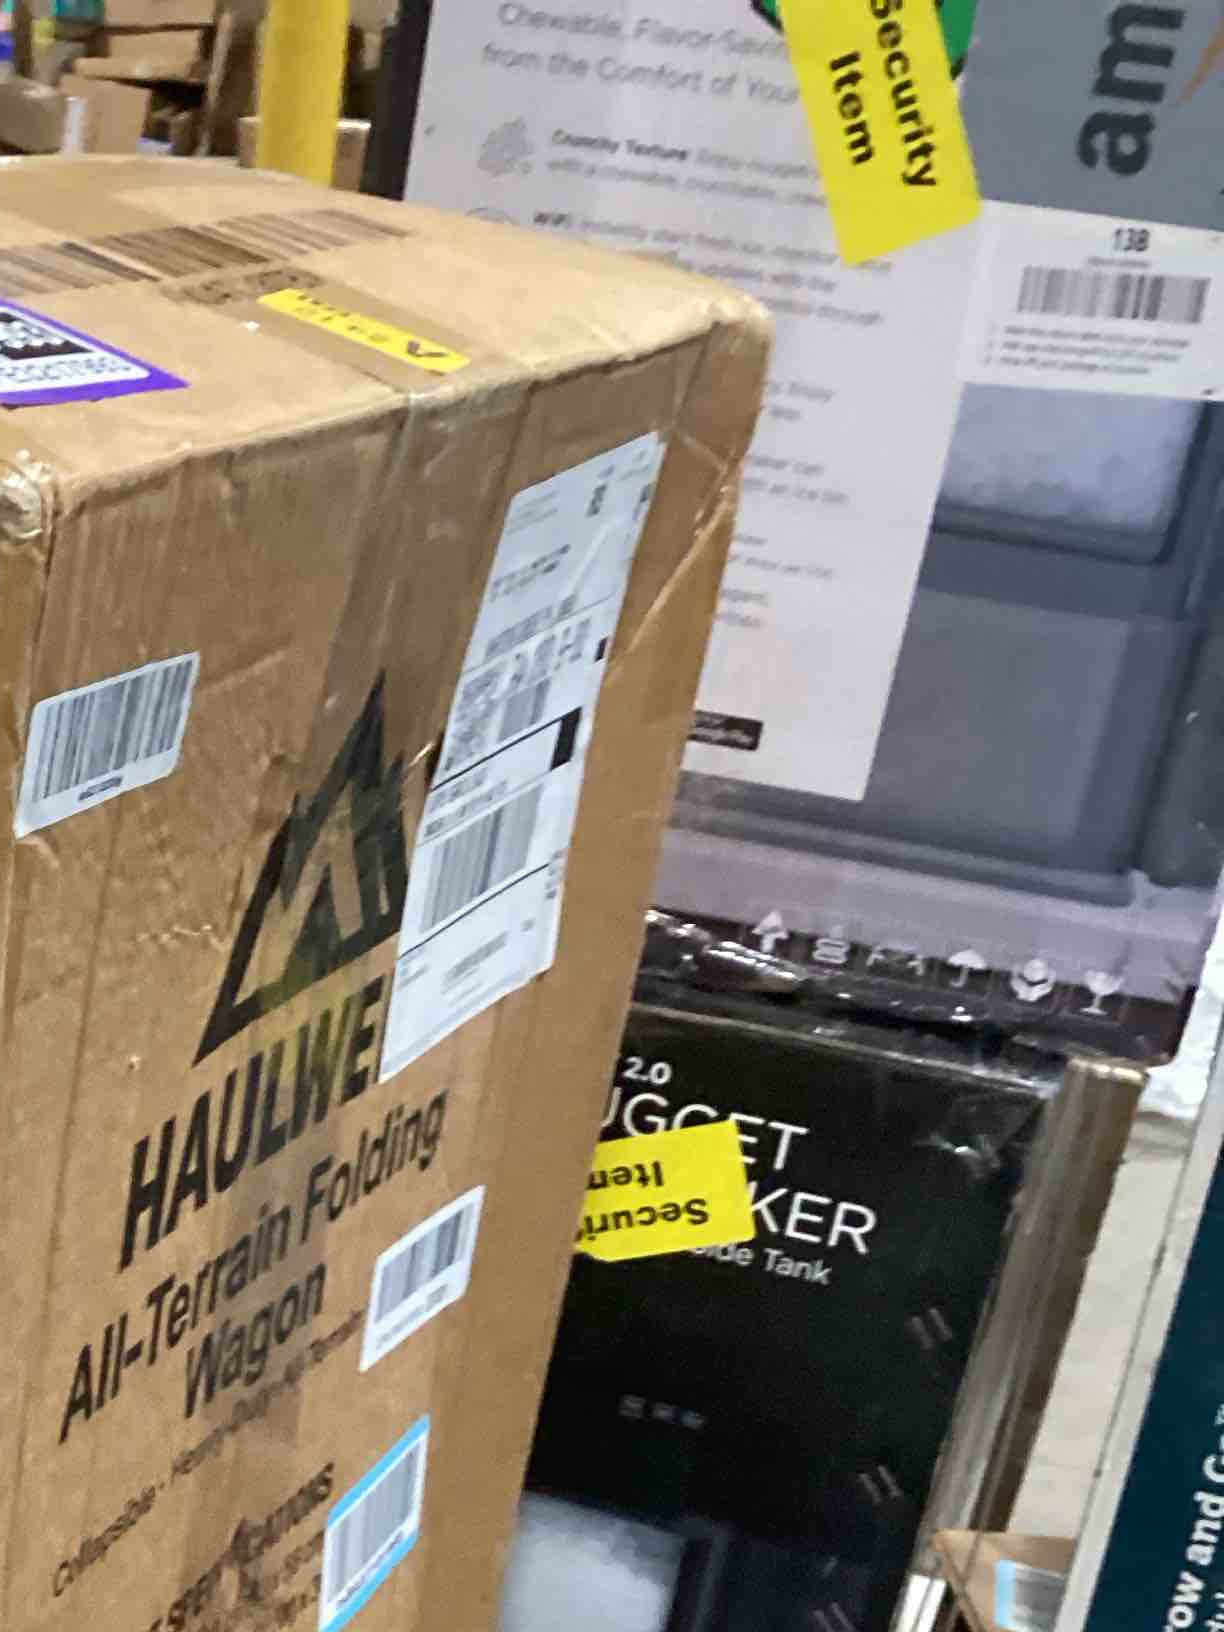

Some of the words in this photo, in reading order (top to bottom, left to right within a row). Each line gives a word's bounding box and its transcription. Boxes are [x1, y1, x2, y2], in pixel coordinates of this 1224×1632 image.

[709, 71, 738, 95] of
[829, 51, 874, 165] Item
[868, 0, 936, 188] Security
[623, 1056, 672, 1085] 2.0
[575, 1197, 710, 1244] Securi
[59, 1202, 290, 1445] All-Terrain
[301, 1088, 449, 1246] Folding
[764, 1247, 833, 1286] Tank
[185, 1262, 327, 1419] Wagon
